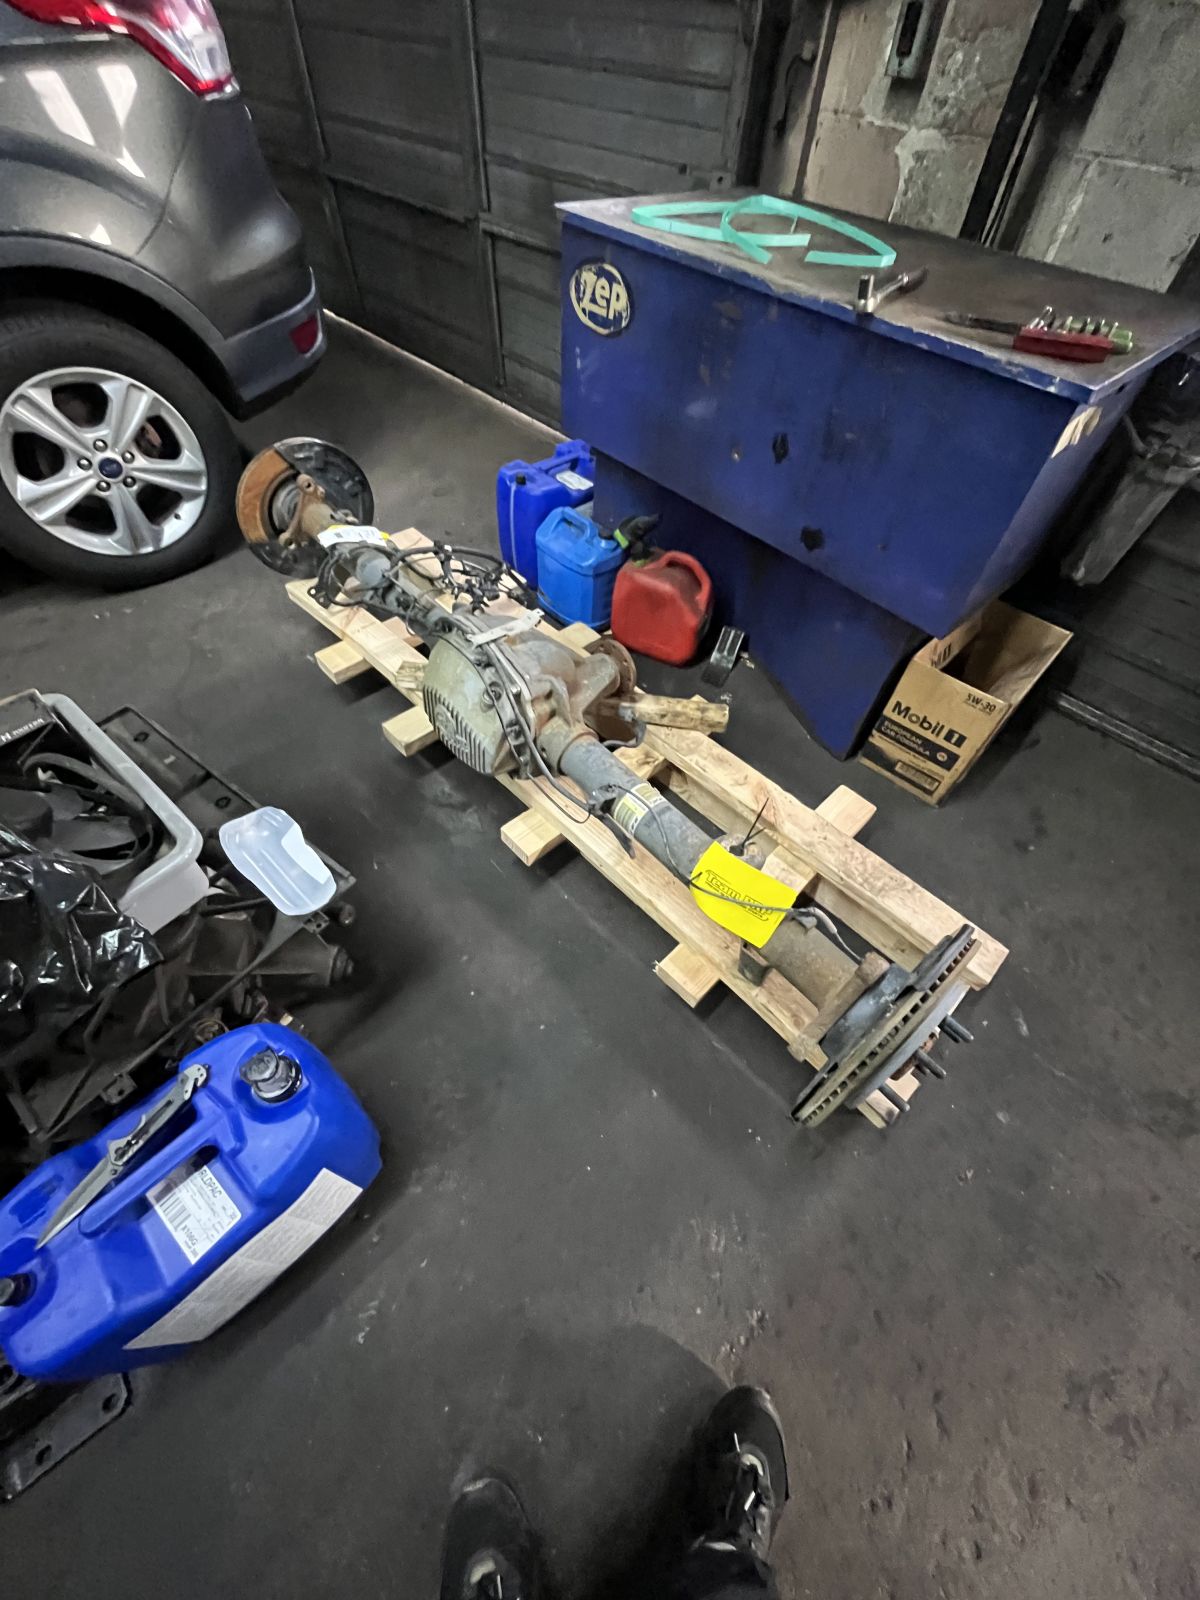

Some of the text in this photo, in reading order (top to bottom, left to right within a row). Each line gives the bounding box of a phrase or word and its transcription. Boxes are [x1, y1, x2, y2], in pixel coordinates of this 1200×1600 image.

[965, 692, 997, 713] 5W-30
[880, 724, 897, 738] CAR
[892, 701, 945, 738] Mobil
[883, 720, 922, 744] EUROPEAN
[706, 872, 742, 900] Team
